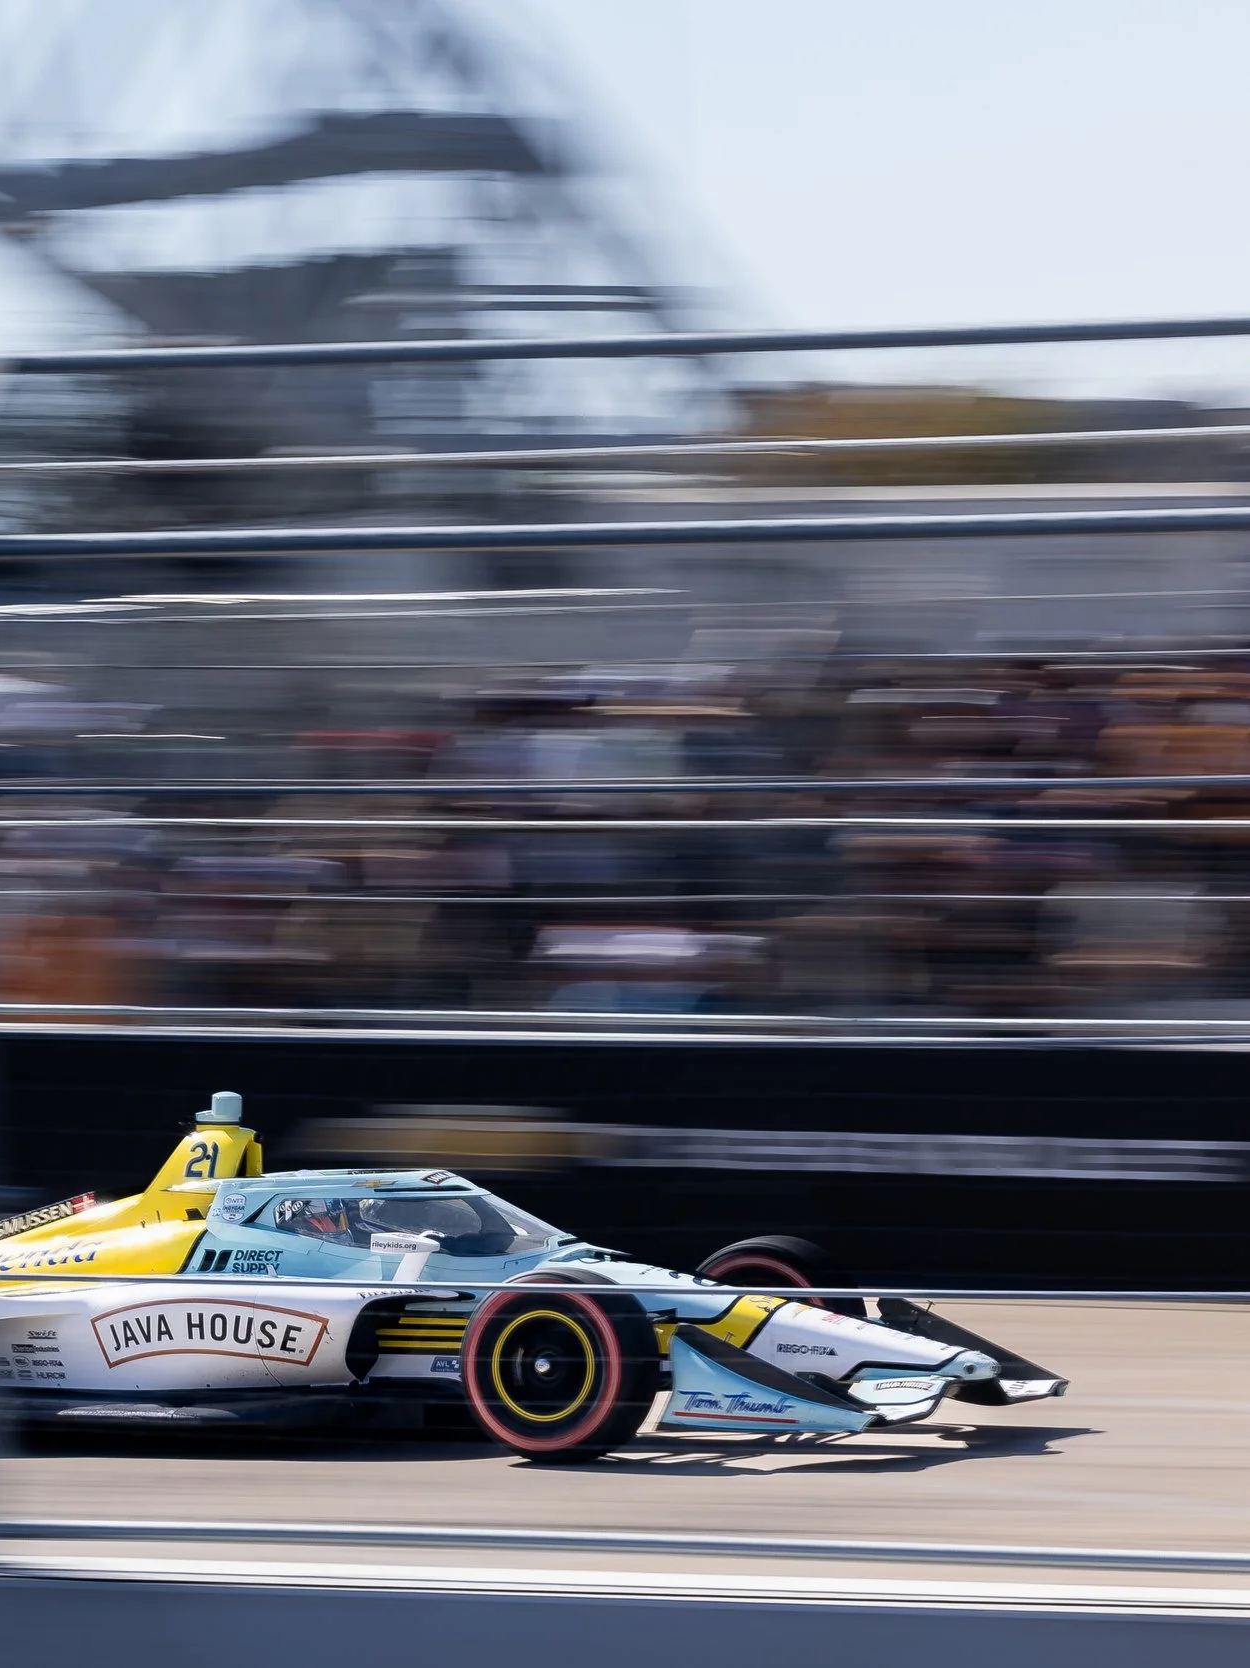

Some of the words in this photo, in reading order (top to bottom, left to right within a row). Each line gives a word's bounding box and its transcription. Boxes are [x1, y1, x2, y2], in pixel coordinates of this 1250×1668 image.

[184, 1141, 220, 1179] 21
[371, 1241, 417, 1250] rileykids.org
[233, 1250, 283, 1262] DIRECT
[231, 1262, 281, 1274] SUPPY
[27, 1329, 57, 1337] Swift
[110, 1313, 174, 1352] JAVA
[186, 1312, 303, 1353] HOUSE
